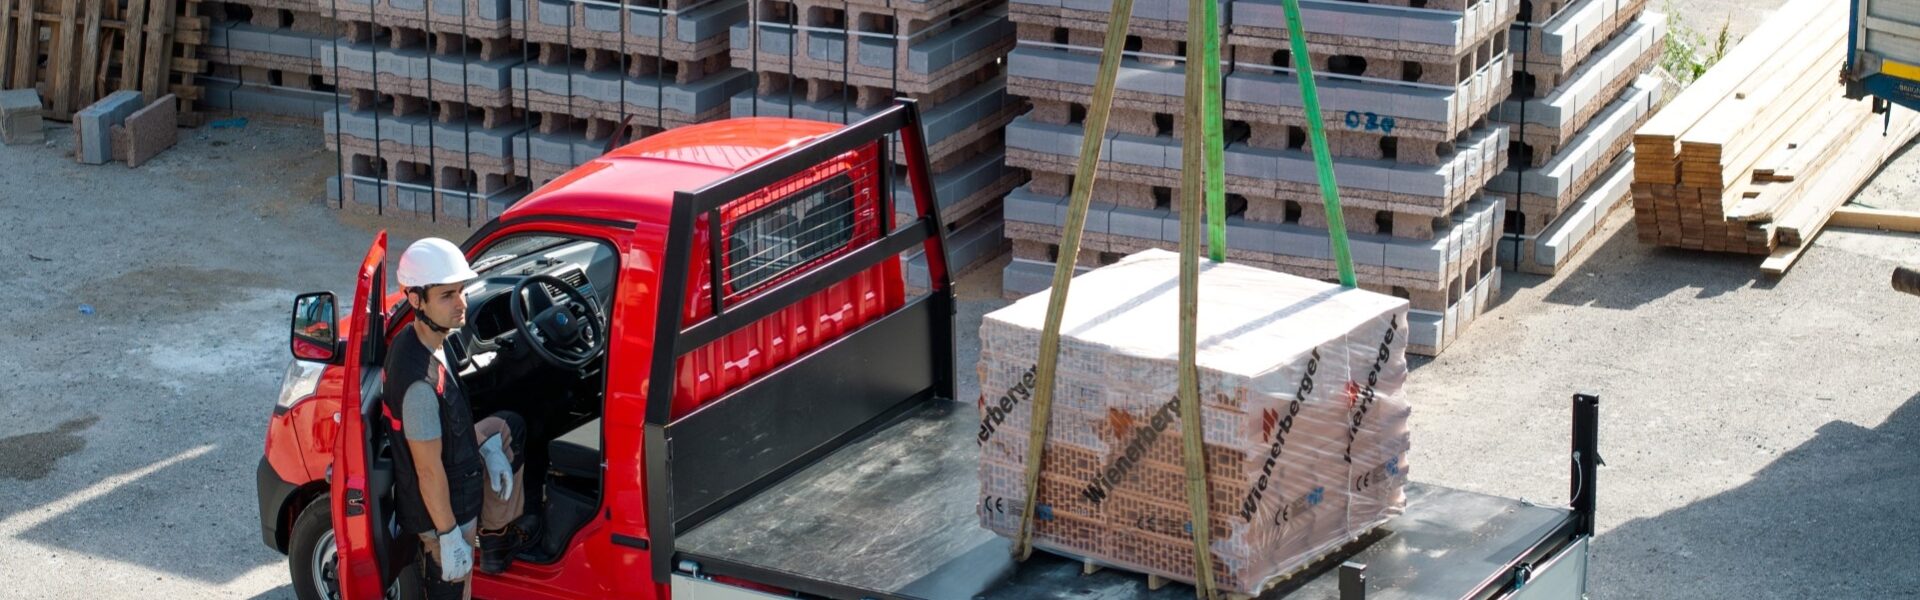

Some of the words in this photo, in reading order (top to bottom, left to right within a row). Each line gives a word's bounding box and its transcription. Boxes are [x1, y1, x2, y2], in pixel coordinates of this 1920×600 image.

[1240, 346, 1321, 523] Wienerberger
[1357, 471, 1371, 492] CE
[985, 495, 1004, 514] CE
[1274, 504, 1289, 526] CE
